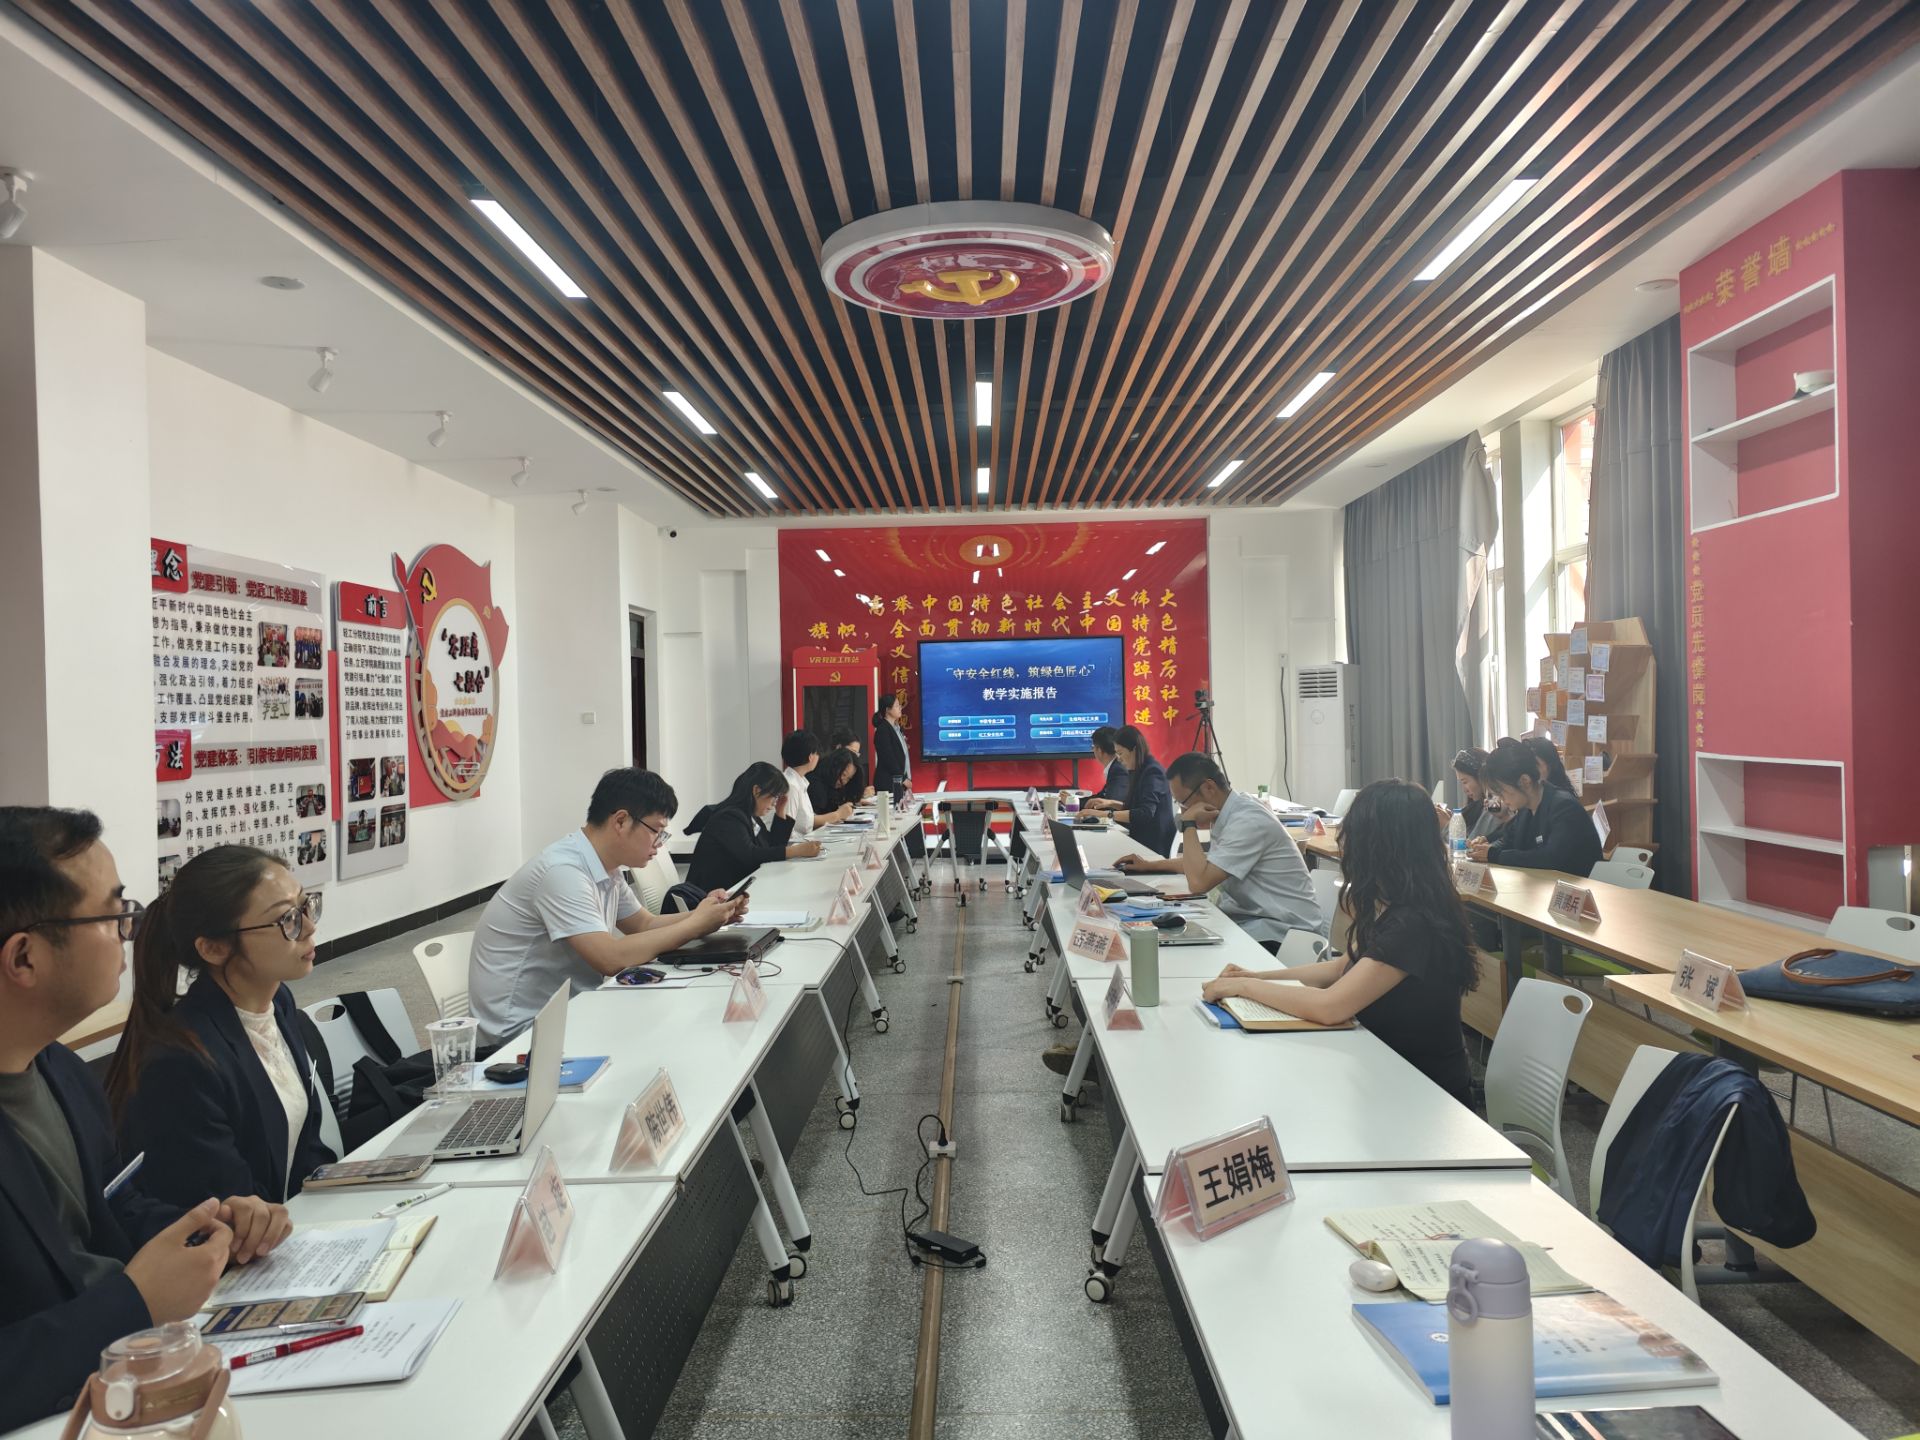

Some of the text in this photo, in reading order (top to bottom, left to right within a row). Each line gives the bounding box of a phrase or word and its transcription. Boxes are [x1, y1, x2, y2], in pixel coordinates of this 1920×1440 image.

[1715, 235, 1792, 307] 荣誉墙
[365, 593, 389, 618] 前言
[982, 686, 1058, 701] 教学实施报告
[1198, 1145, 1276, 1208] 王娟梅
